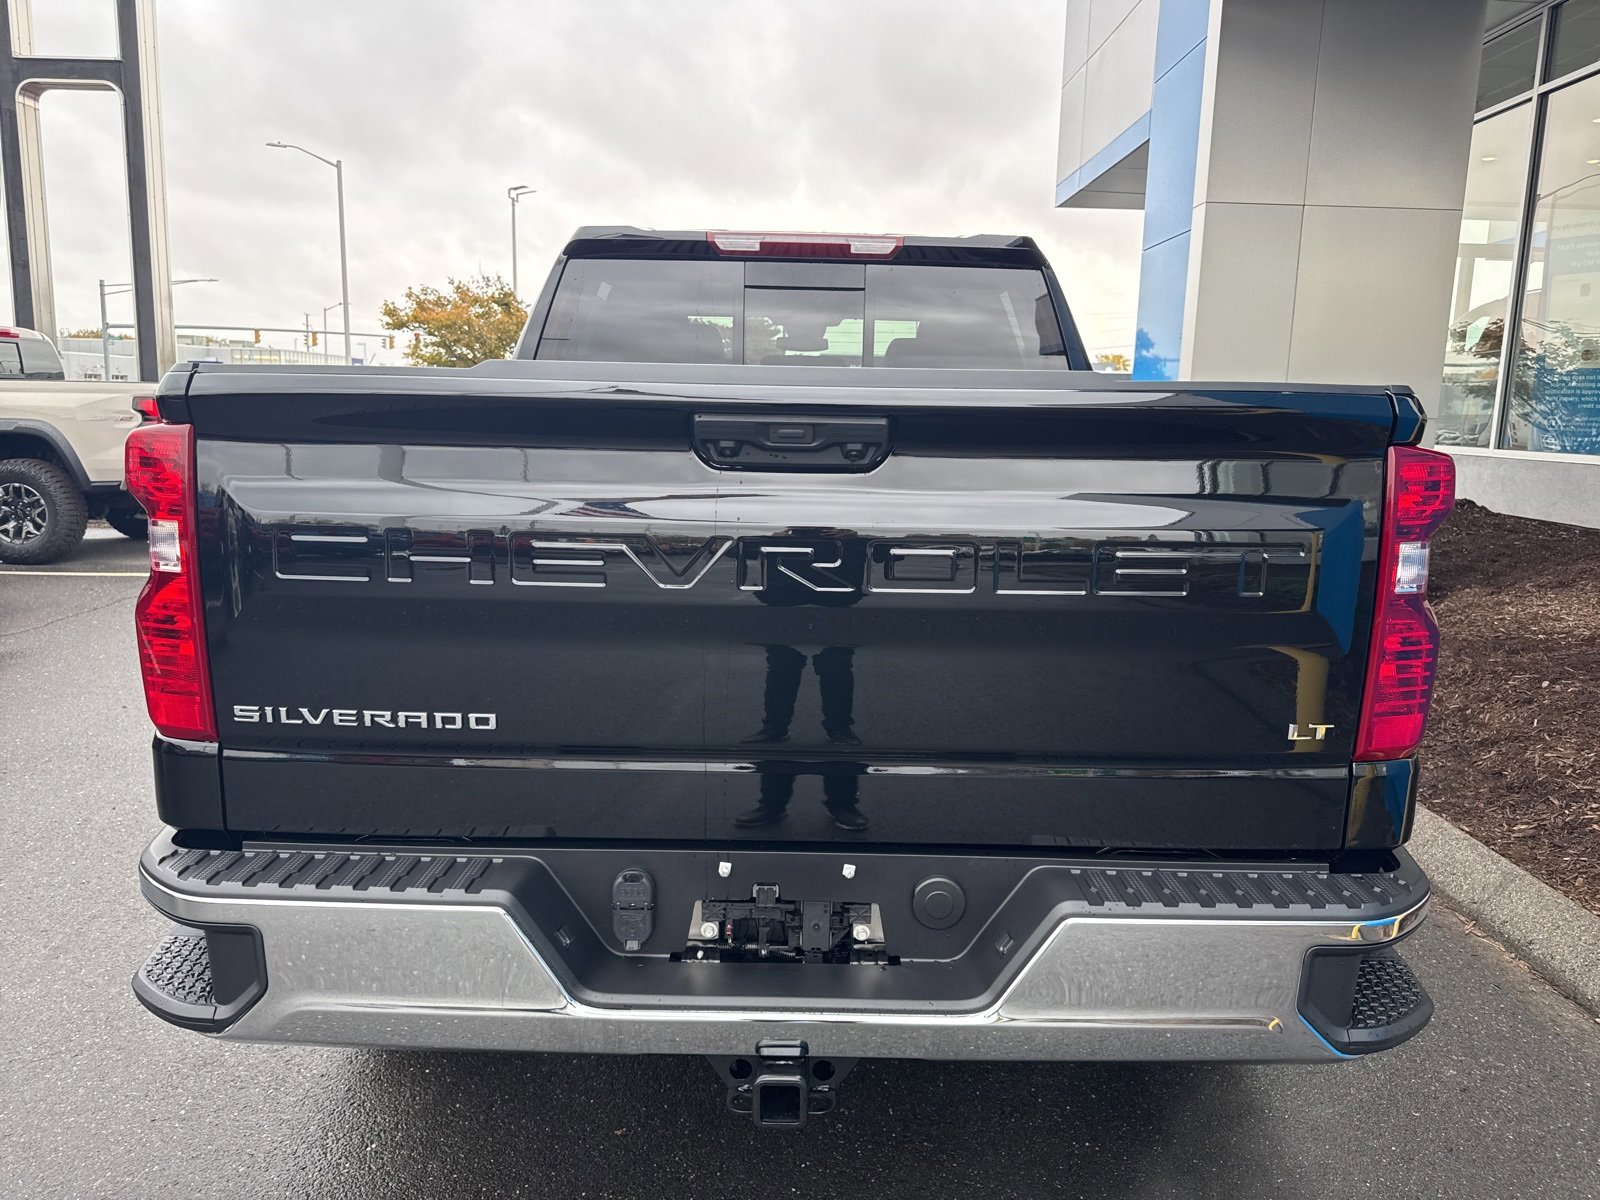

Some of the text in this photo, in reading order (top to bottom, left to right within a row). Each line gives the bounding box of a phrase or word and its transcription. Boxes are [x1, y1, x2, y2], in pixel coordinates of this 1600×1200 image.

[272, 528, 1305, 597] CHEVROLET
[233, 705, 497, 730] SILVERADO
[1287, 723, 1335, 740] LT
